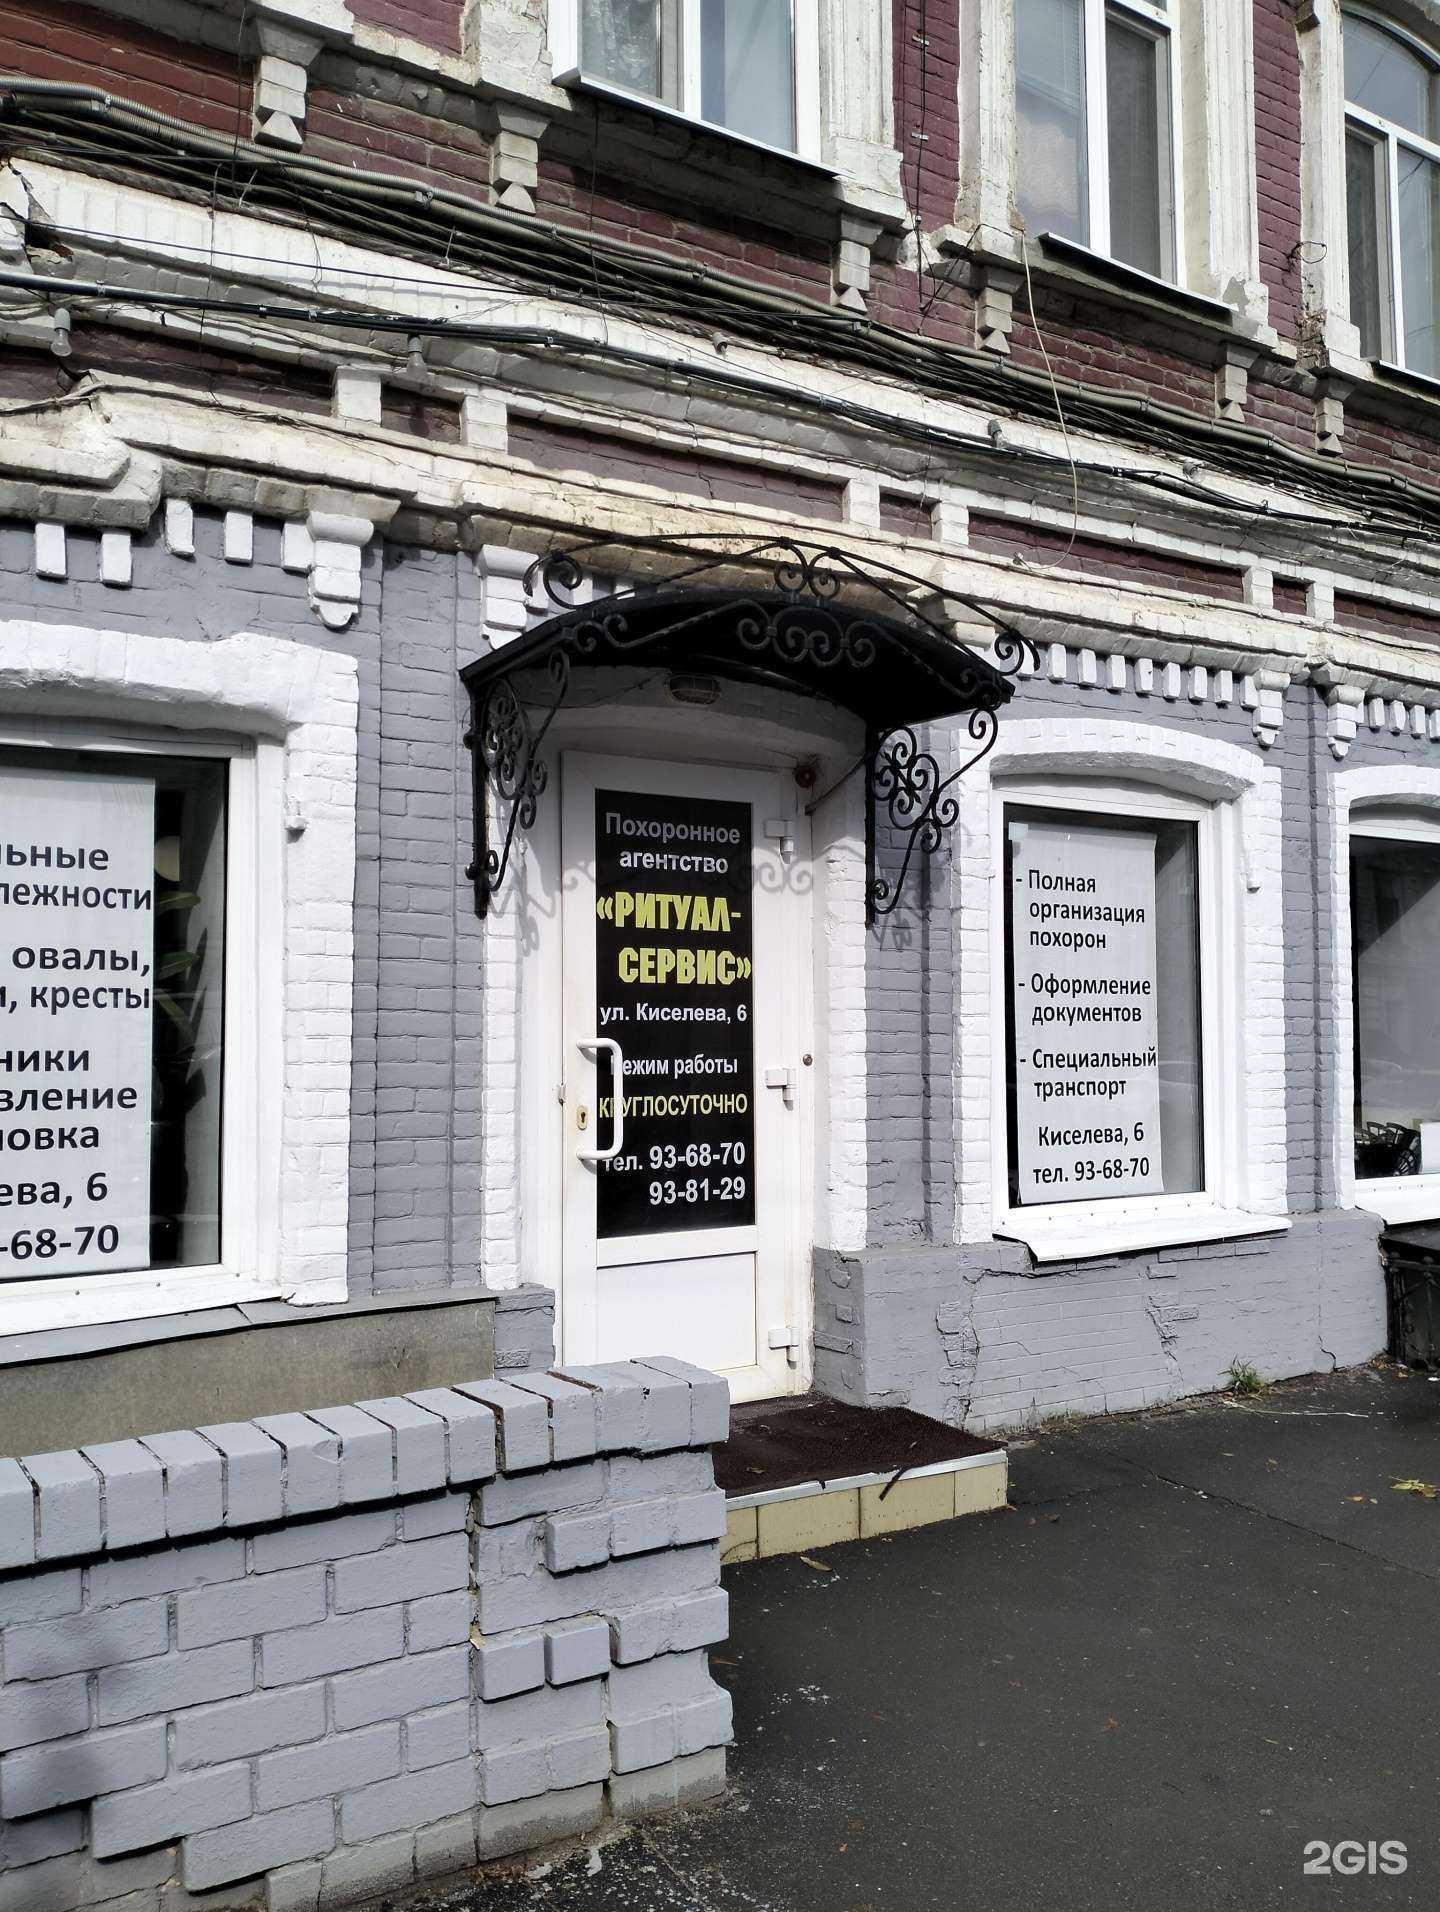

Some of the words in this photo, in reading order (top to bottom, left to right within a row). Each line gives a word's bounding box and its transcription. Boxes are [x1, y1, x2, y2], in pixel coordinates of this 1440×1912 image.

[605, 811, 742, 845] Похоронное
[0, 844, 110, 871] ьные
[619, 850, 729, 875] агентство
[1028, 869, 1096, 893] Полная
[596, 891, 742, 932] «РИТУАЛ-
[1029, 901, 1145, 926] организация
[1029, 930, 1106, 952] похорон
[12, 945, 152, 976] овалы,
[618, 947, 752, 985] СЕРВИС»
[1031, 973, 1151, 998] Оформление
[30, 984, 150, 1016] кресты
[600, 1006, 631, 1025] ул.
[635, 1002, 732, 1024] Киселева,
[736, 1004, 748, 1022] 6
[1031, 1005, 1142, 1027] документов
[610, 1055, 669, 1075] ежим
[674, 1053, 738, 1079] работы
[1032, 1046, 1157, 1072] Специальный
[1033, 1080, 1127, 1102] транспорт
[1038, 1126, 1129, 1147] Киселева,
[1133, 1122, 1145, 1141] 6
[602, 1156, 643, 1172] тел.
[649, 1141, 746, 1169] 93-68-70
[1033, 1167, 1069, 1184] тел.
[1074, 1157, 1150, 1181] 93-68-70
[86, 1172, 109, 1203] 6
[649, 1176, 746, 1205] 93-81-29
